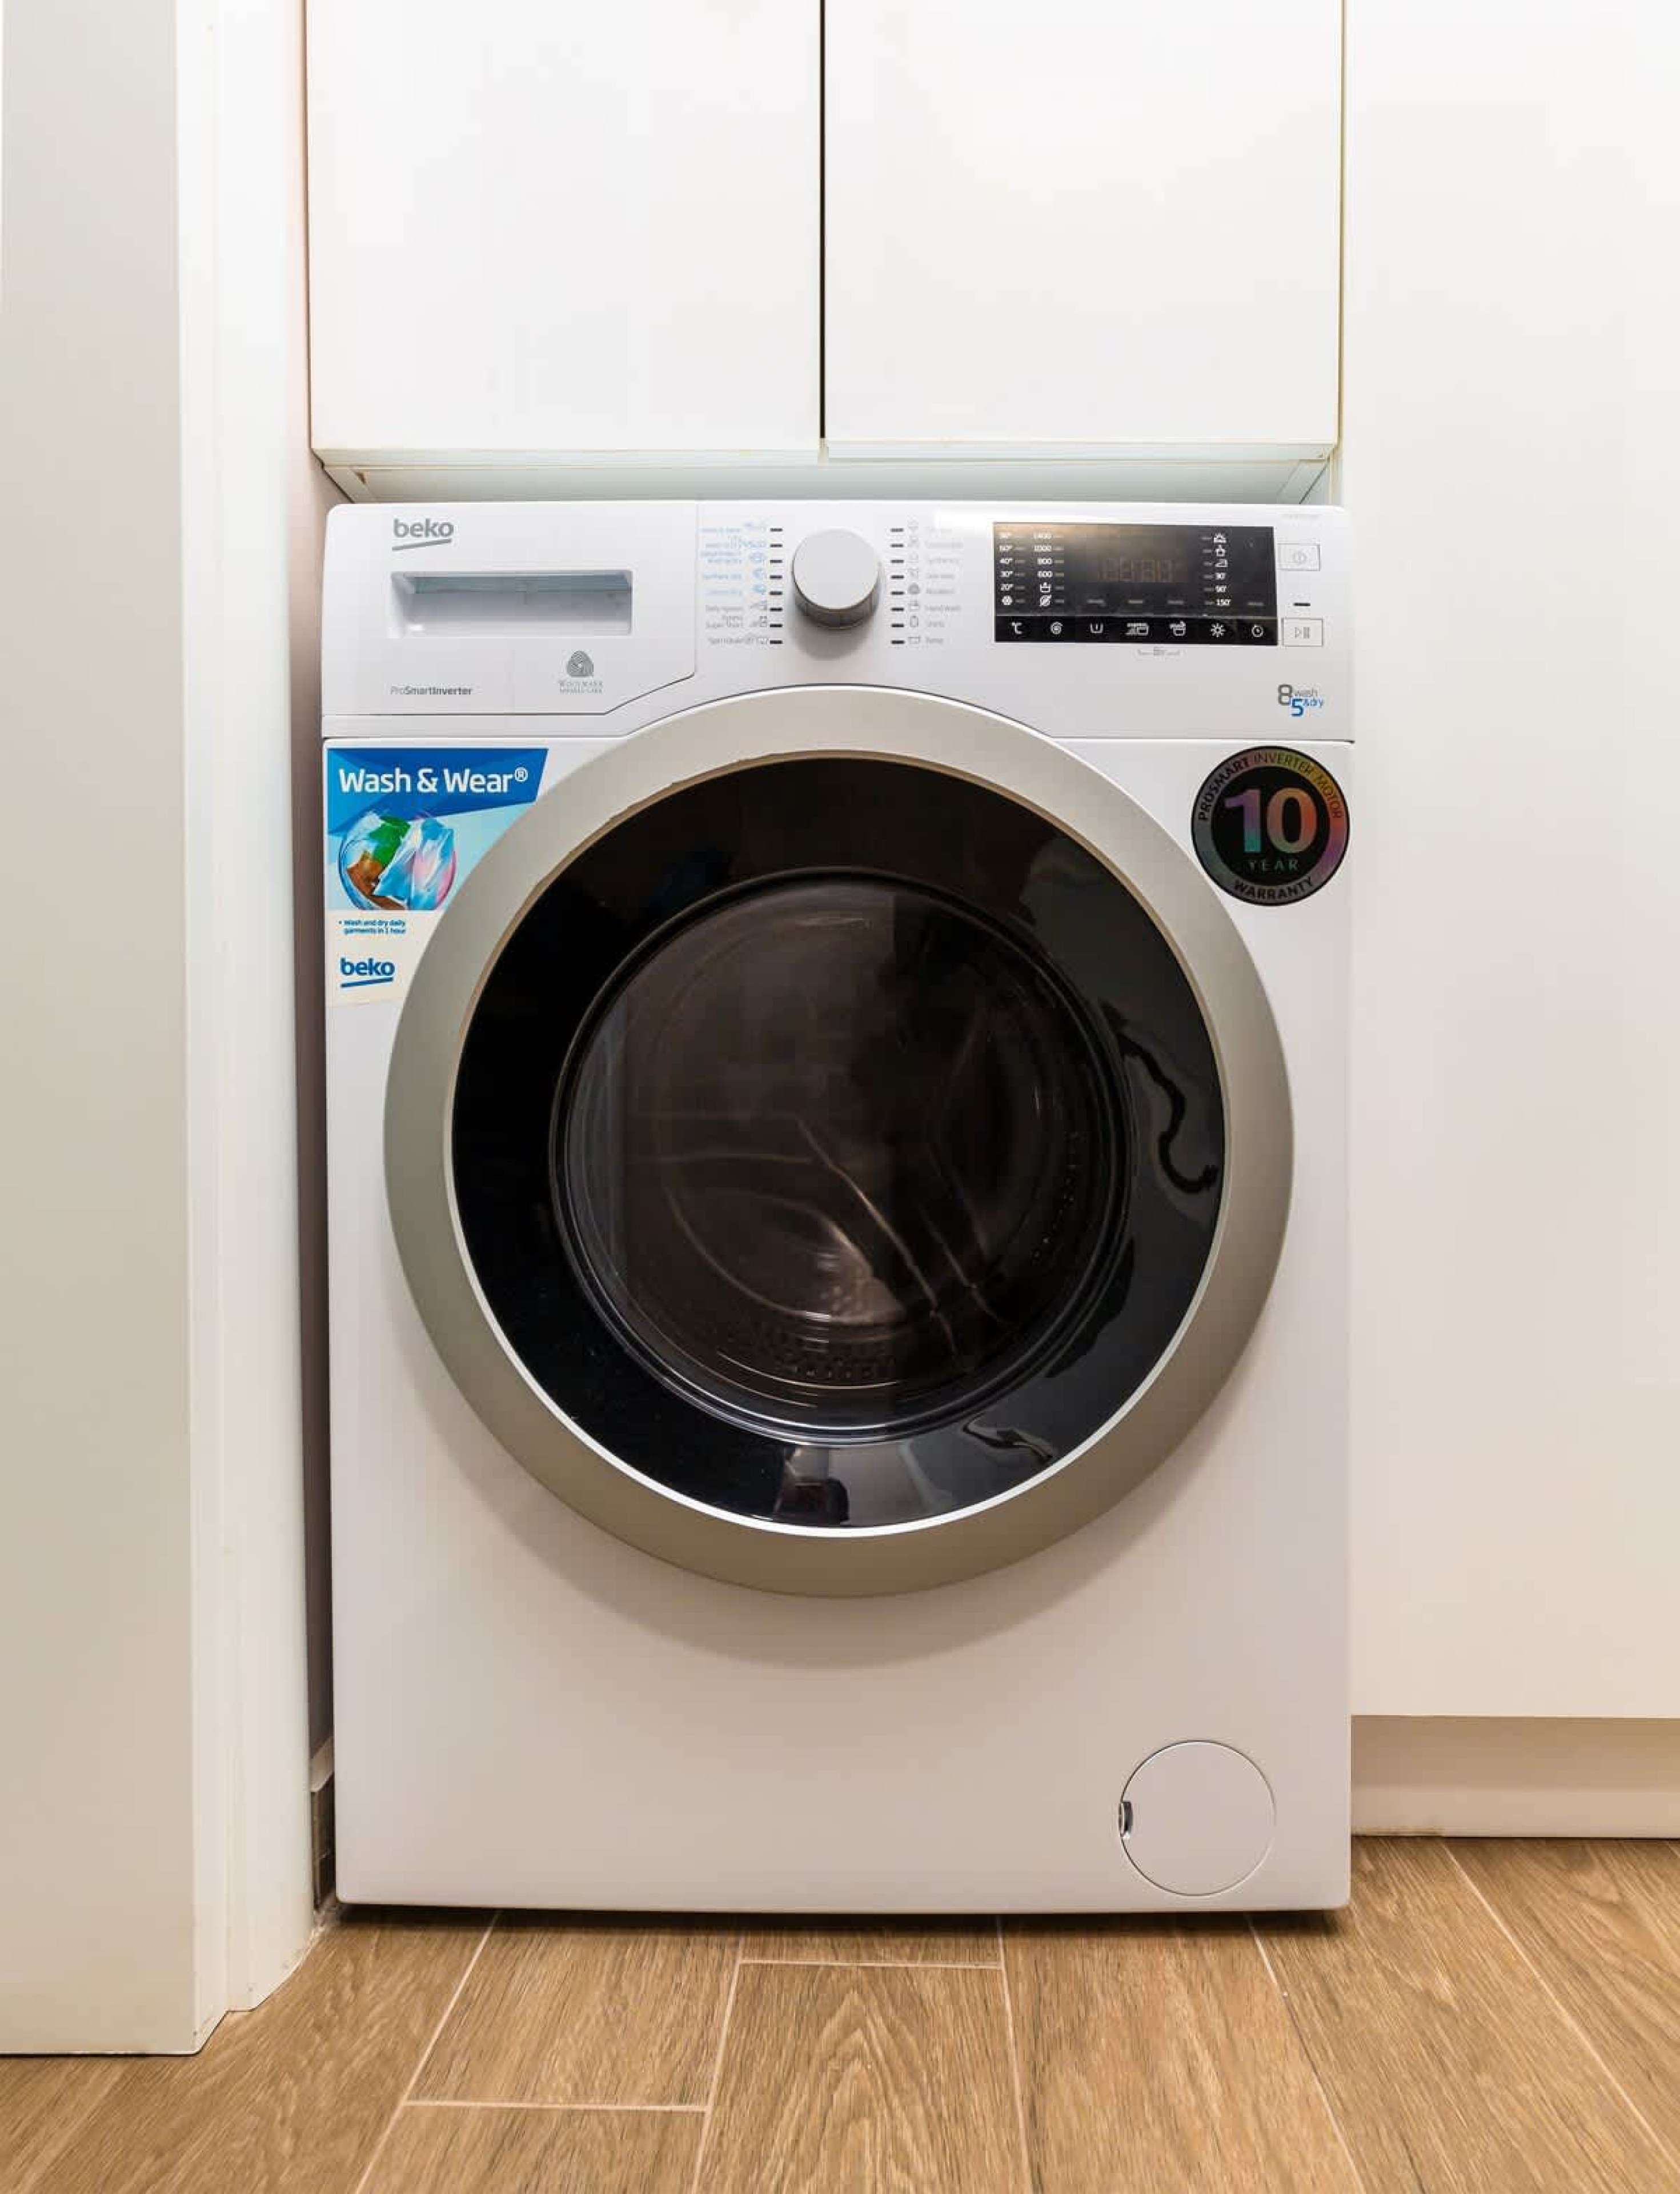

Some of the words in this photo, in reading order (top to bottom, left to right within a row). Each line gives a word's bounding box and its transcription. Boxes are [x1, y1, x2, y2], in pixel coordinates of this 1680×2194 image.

[394, 518, 454, 538] beko
[390, 686, 472, 695] ProSmartInverter
[1278, 684, 1293, 706] 8
[1291, 698, 1304, 717] 5
[339, 767, 411, 794] Wash
[417, 767, 438, 794] &
[1198, 757, 1249, 822] PROSMART
[1253, 752, 1314, 778] INVERTER
[1314, 773, 1344, 819] MOTOR
[1224, 787, 1318, 853] 10
[1249, 858, 1300, 872] YEAR
[1234, 875, 1313, 900] WARRANTY
[378, 919, 388, 927] dry
[389, 919, 406, 927] daily
[340, 957, 395, 976] beko
